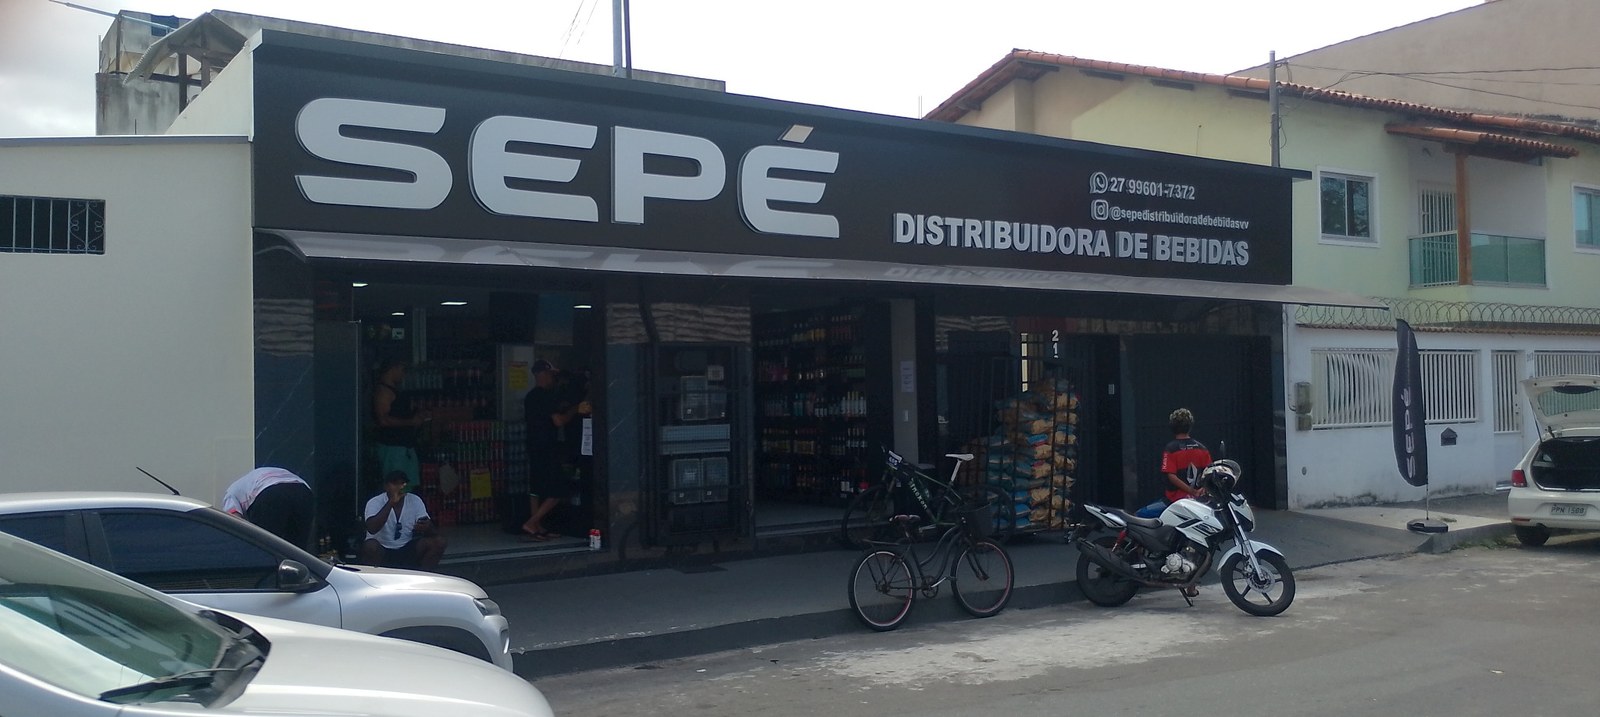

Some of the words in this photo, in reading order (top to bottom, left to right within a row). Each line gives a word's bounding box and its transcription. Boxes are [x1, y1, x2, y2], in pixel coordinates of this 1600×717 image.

[295, 97, 840, 239] SEPÉ
[1110, 176, 1125, 194] 27
[1127, 179, 1196, 201] 99601-7372
[893, 211, 1110, 258] DISTRIBUIDORA
[1115, 230, 1149, 260] DE
[1152, 234, 1250, 267] BEBIDAS
[1051, 329, 1060, 359] 21
[1401, 388, 1416, 479] SEPÉ
